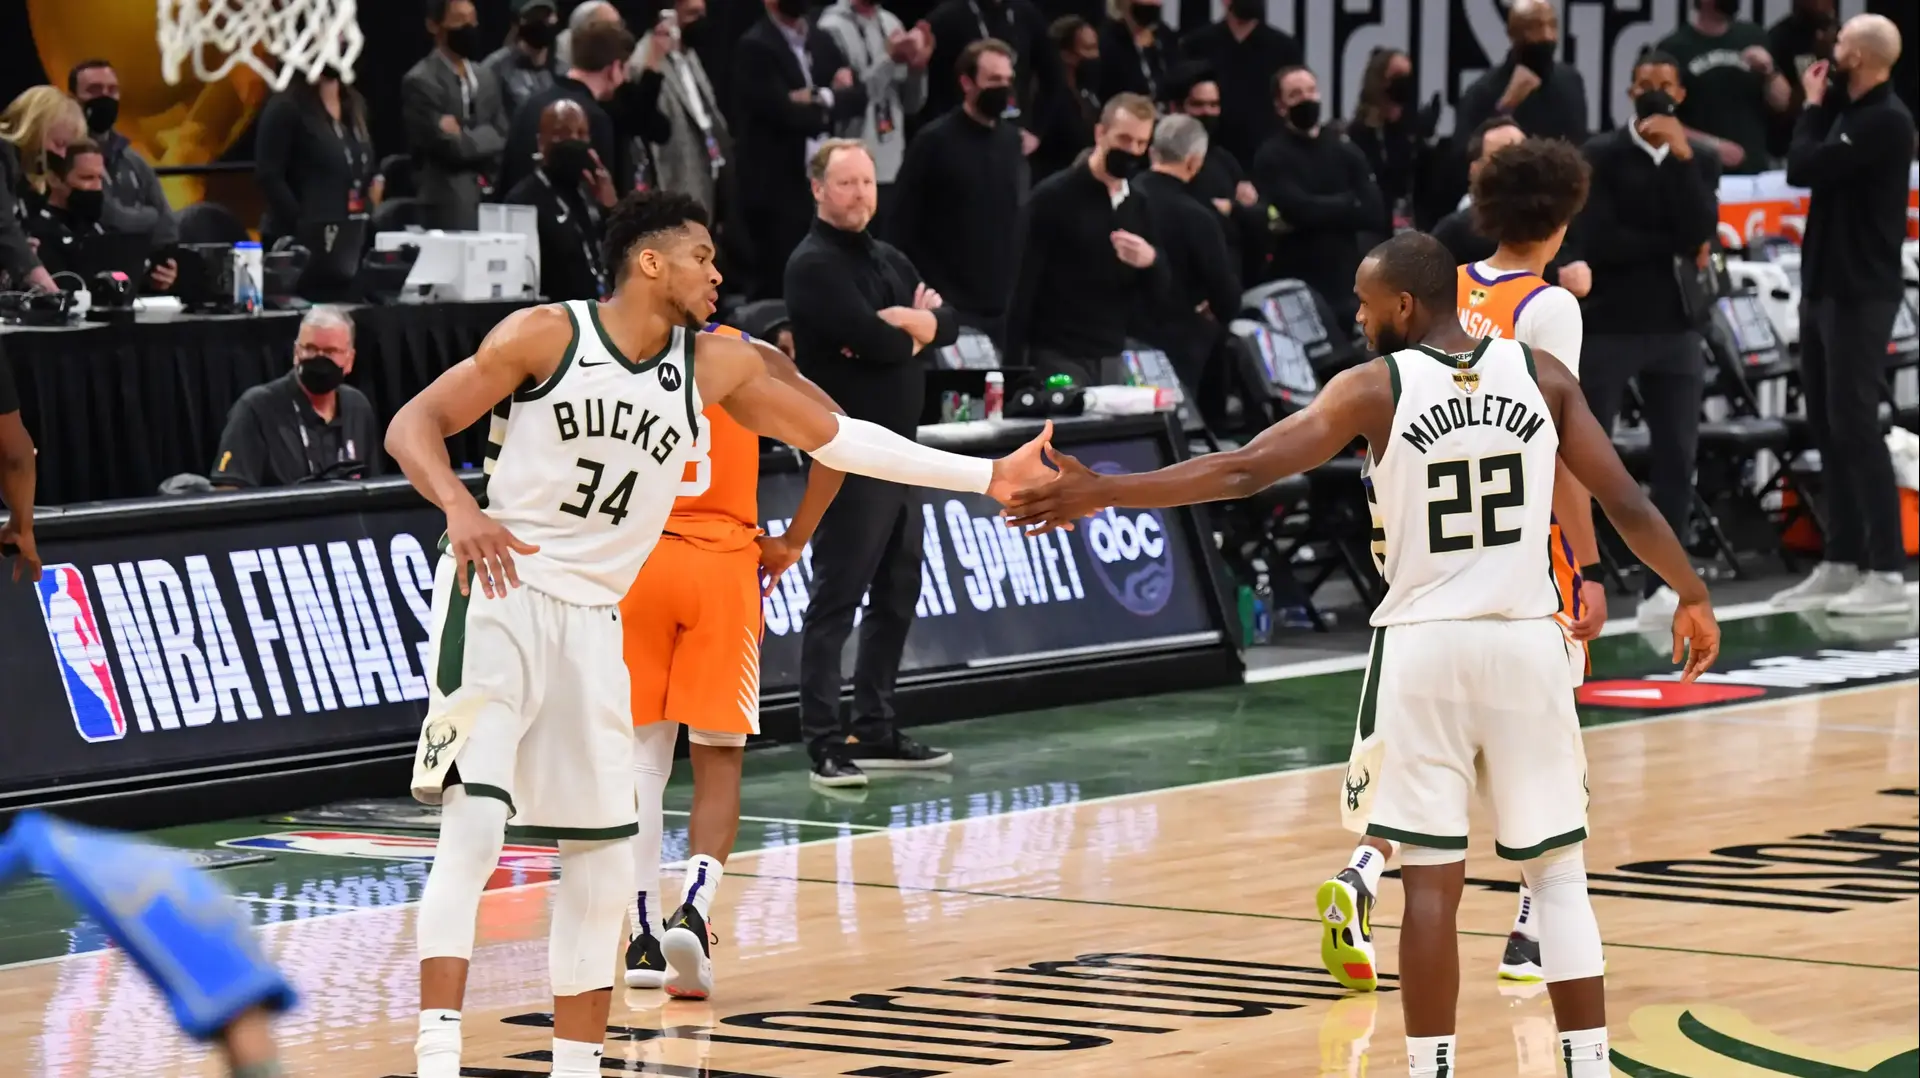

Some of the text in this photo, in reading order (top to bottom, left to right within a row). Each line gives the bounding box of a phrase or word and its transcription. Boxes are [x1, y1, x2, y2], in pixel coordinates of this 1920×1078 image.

[1457, 307, 1503, 340] NSON
[553, 398, 681, 465] BUCKS
[1401, 393, 1546, 455] MIDDLETON
[559, 457, 639, 526] 34
[1427, 452, 1525, 554] 22
[1089, 506, 1164, 565] abc
[93, 533, 434, 733] NBA FINALS
